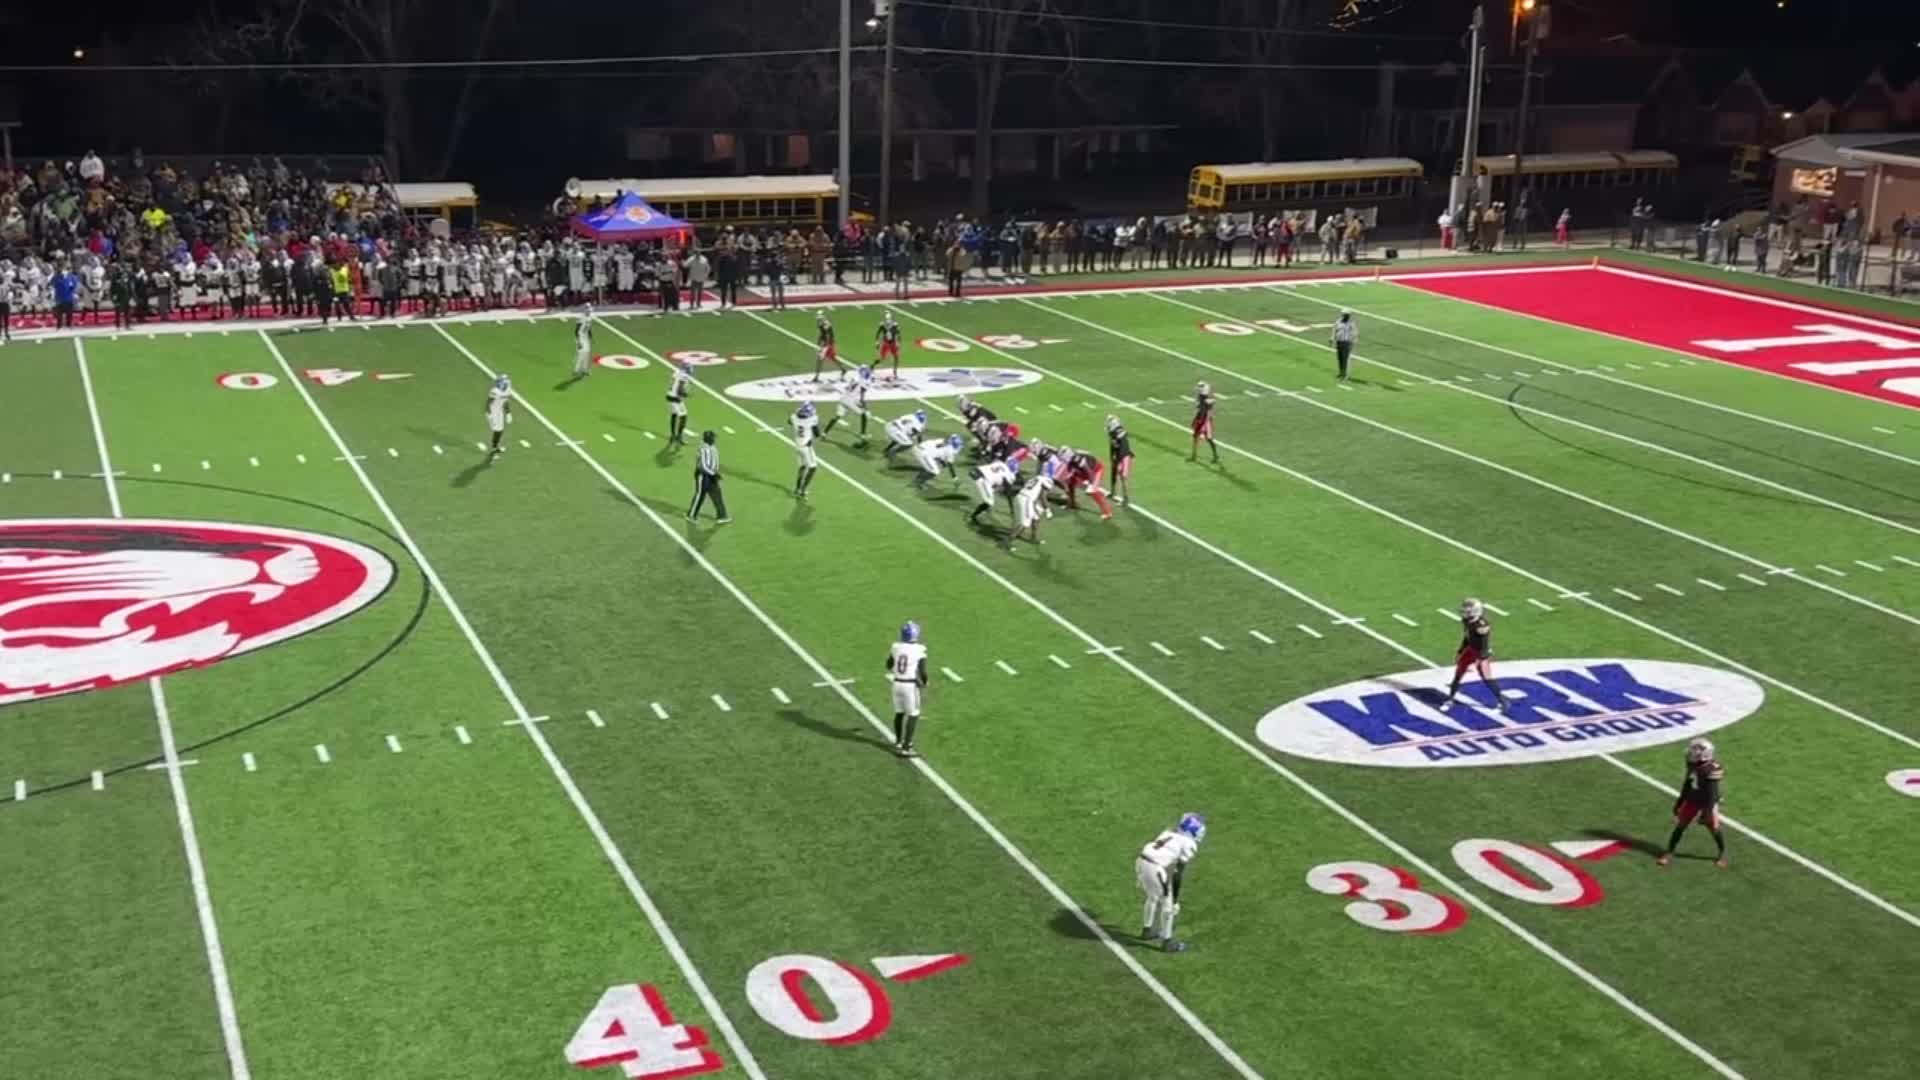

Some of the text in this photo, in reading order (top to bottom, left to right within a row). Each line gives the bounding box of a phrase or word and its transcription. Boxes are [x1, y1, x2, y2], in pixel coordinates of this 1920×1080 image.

[1306, 663, 1700, 745] KIRK
[1418, 710, 1697, 761] AUTO GROUP
[1305, 838, 1605, 935] 30
[563, 953, 893, 1080] 40
